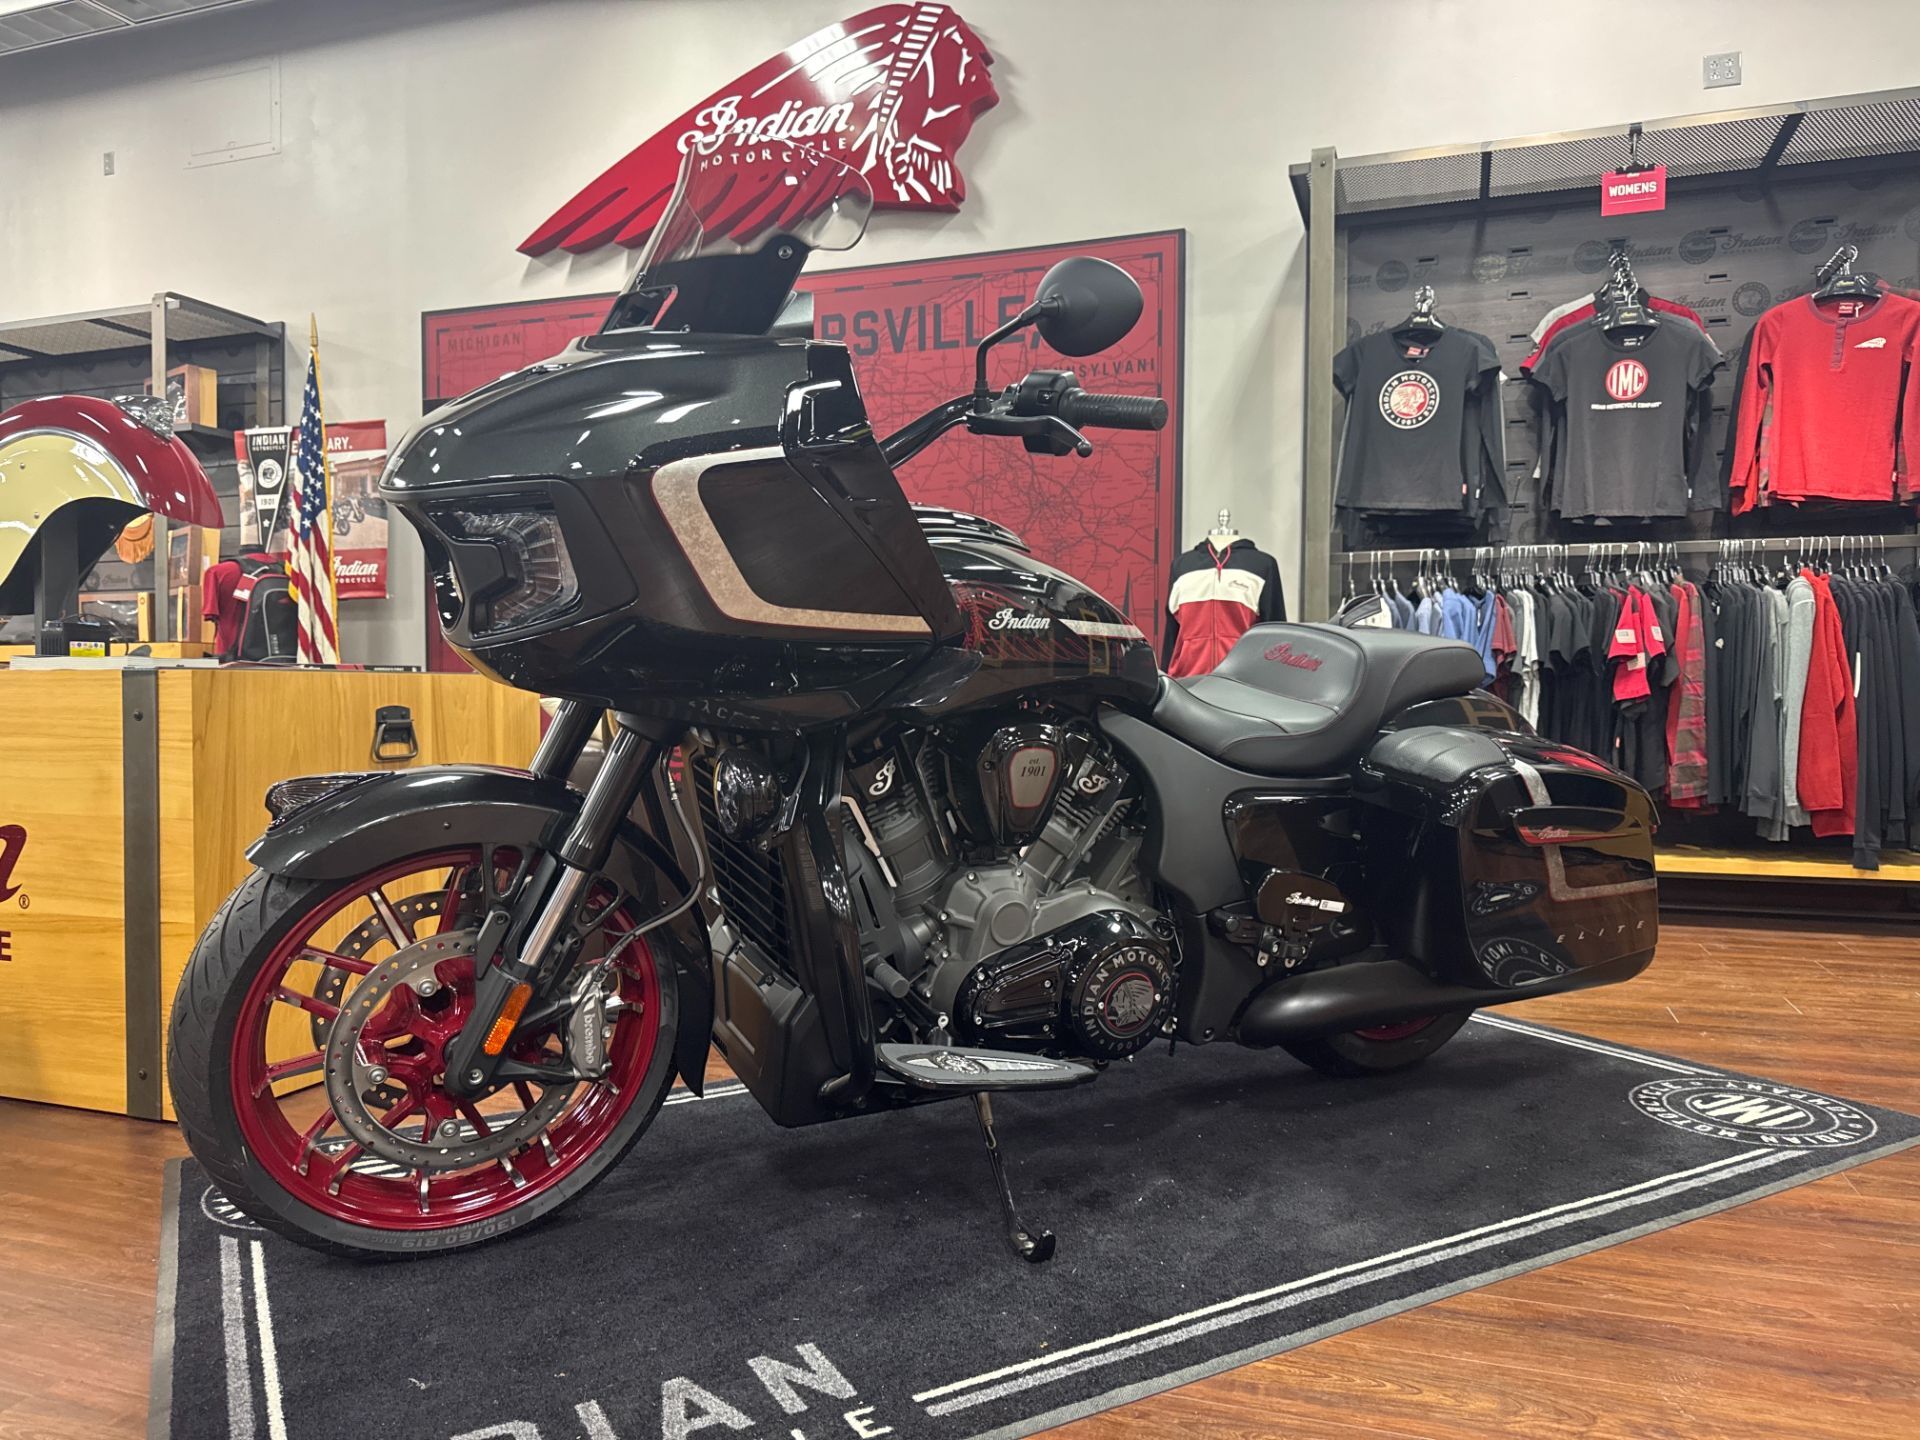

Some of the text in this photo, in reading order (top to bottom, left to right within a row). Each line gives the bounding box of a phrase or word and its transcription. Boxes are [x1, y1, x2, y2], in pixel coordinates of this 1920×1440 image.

[700, 137, 847, 173] MOTORCYCLE
[1608, 181, 1657, 197] WOMENS
[448, 332, 521, 352] MICHIGAN
[1611, 363, 1644, 396] IMC
[1383, 374, 1436, 417] INDIAN MOTORCYCLE
[252, 433, 285, 446] INDIAN
[261, 498, 275, 506] 1901
[988, 607, 1051, 631] Indian
[1263, 642, 1323, 672] Indian
[1021, 766, 1047, 777] 1901
[1556, 920, 1645, 944] ELITE
[1084, 951, 1171, 1038] INDIAN MOTORCYCLE
[583, 1012, 597, 1065] brembo
[1639, 1081, 1861, 1145] INDIAN MOTORCYCLE
[1691, 1094, 1806, 1127] IMC
[1725, 1081, 1861, 1120] COMPANY
[402, 1238, 439, 1249] R19
[445, 1215, 517, 1245] 130/60
